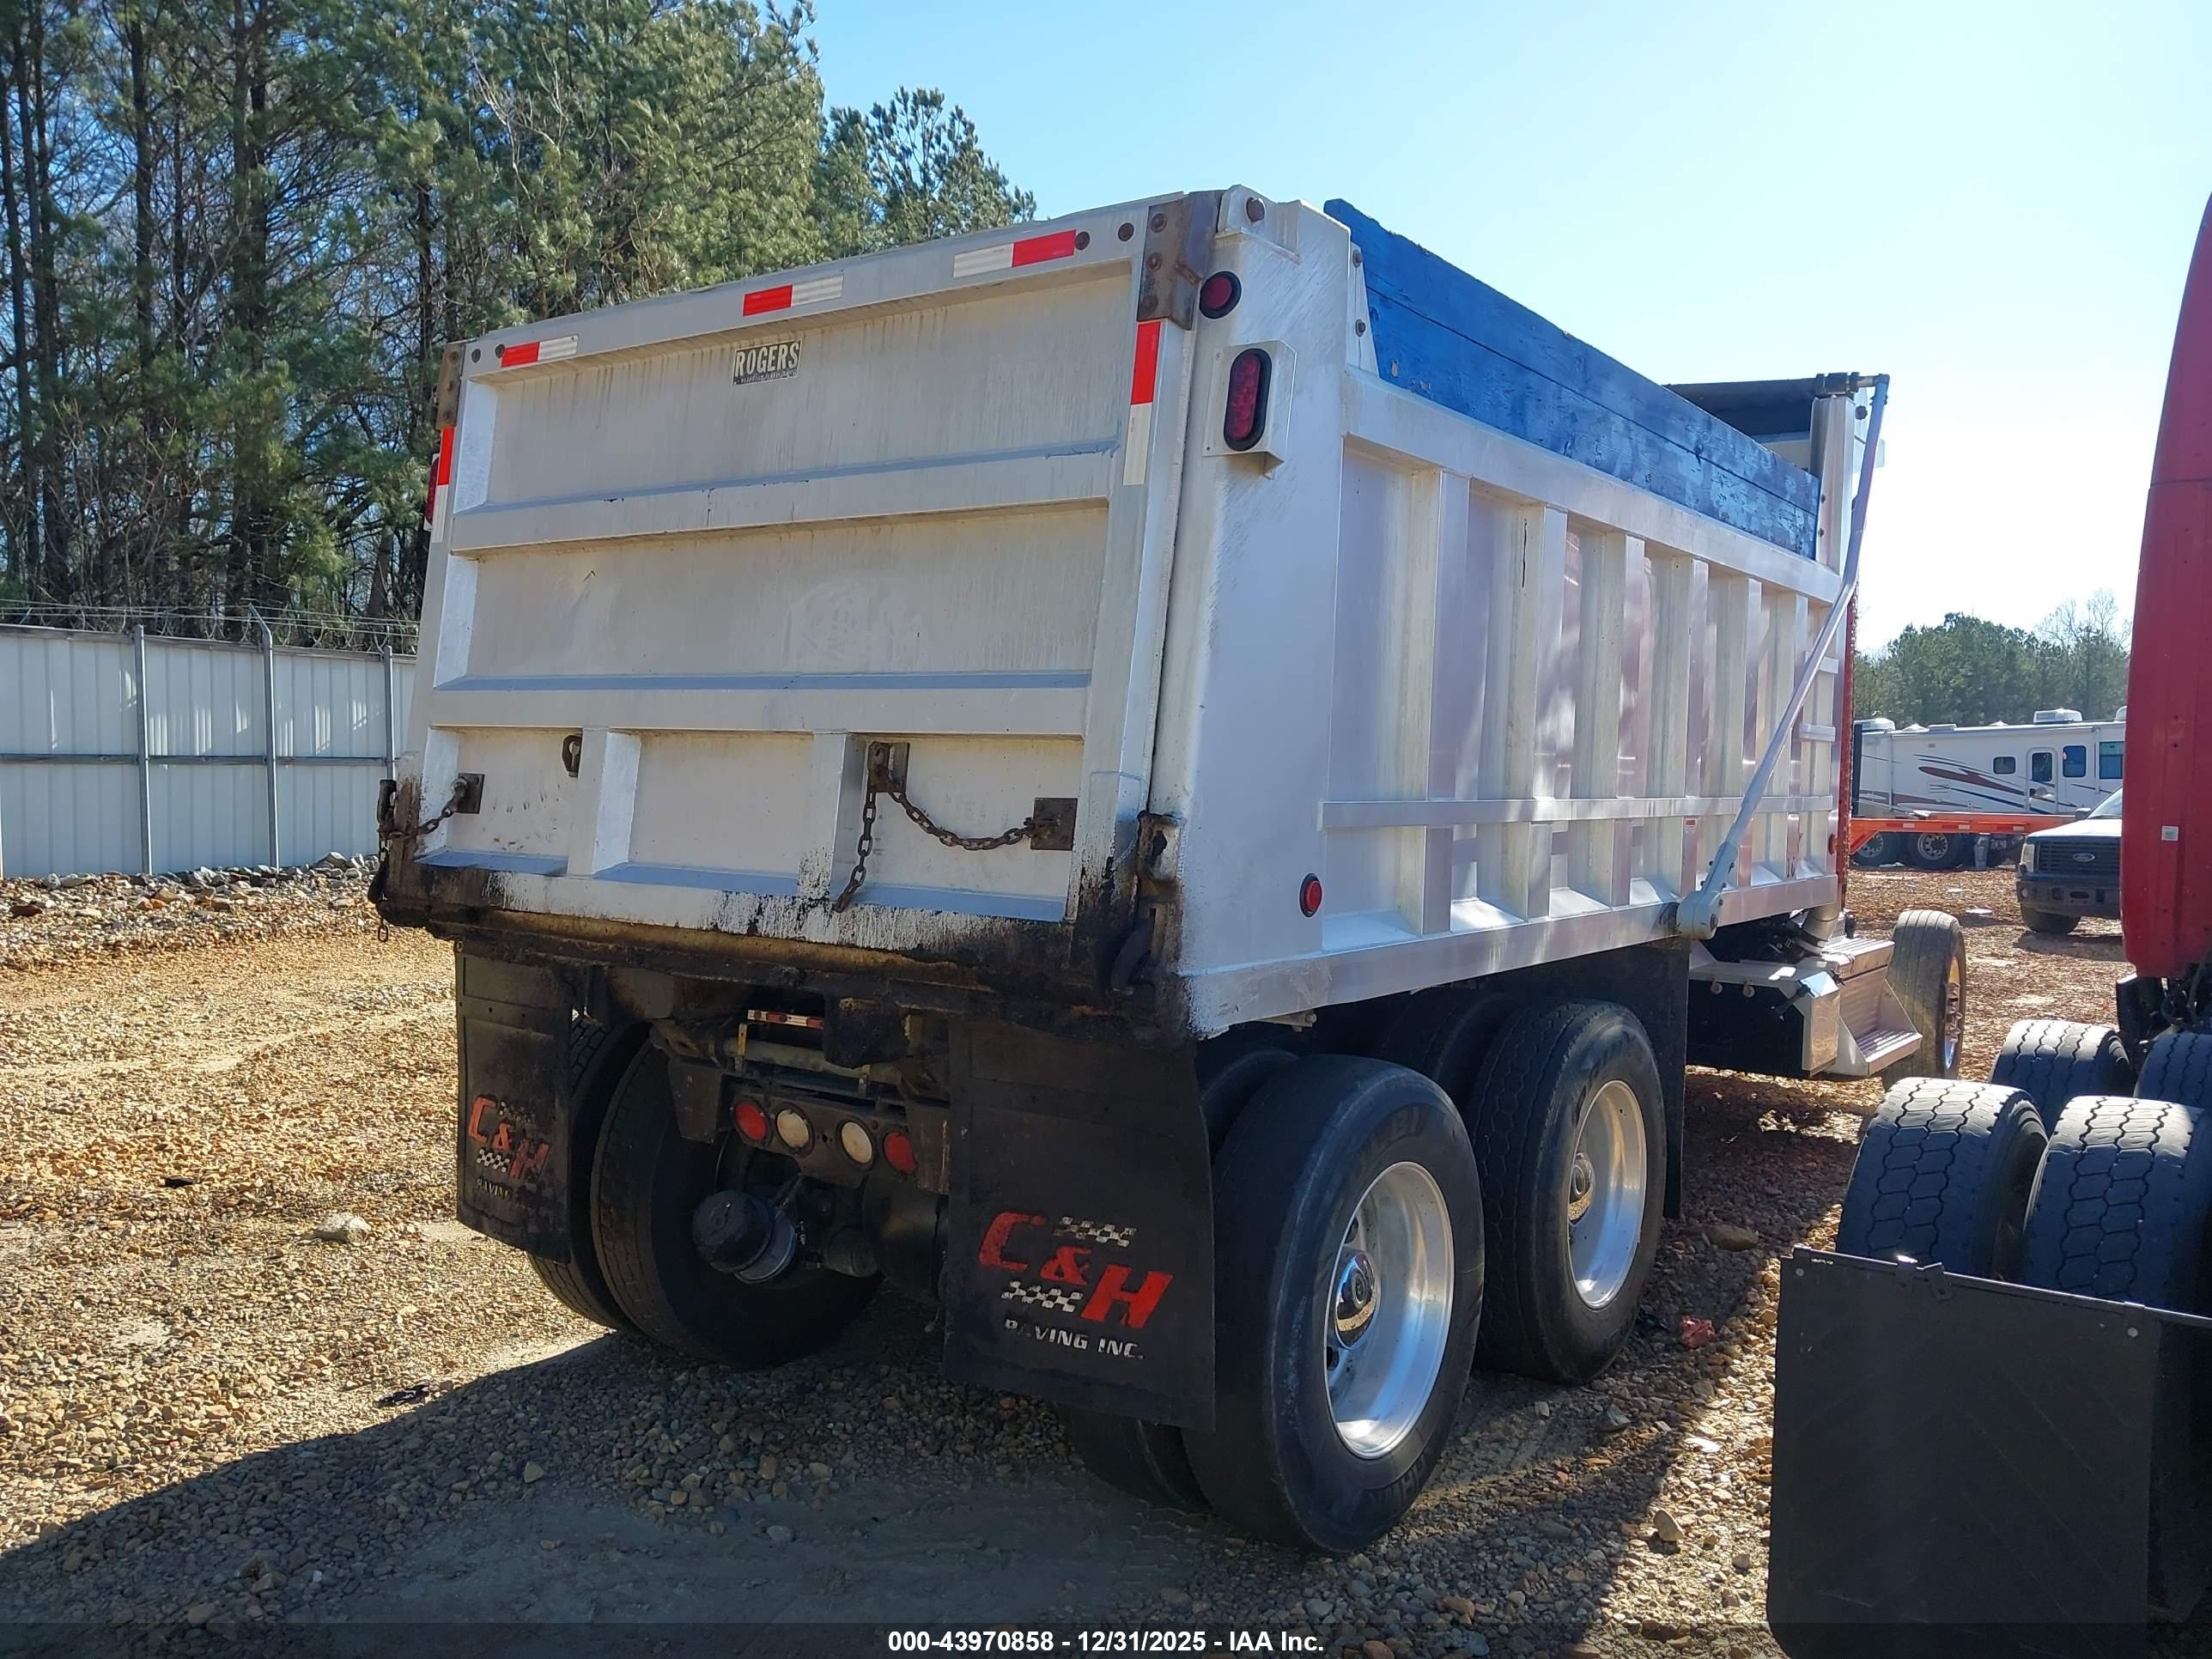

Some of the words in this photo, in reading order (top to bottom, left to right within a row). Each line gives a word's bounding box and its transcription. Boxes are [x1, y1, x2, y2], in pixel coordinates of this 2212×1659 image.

[735, 341, 799, 377] ROGERS
[1004, 1318, 1088, 1350] PVING
[1097, 1336, 1145, 1359] INC.
